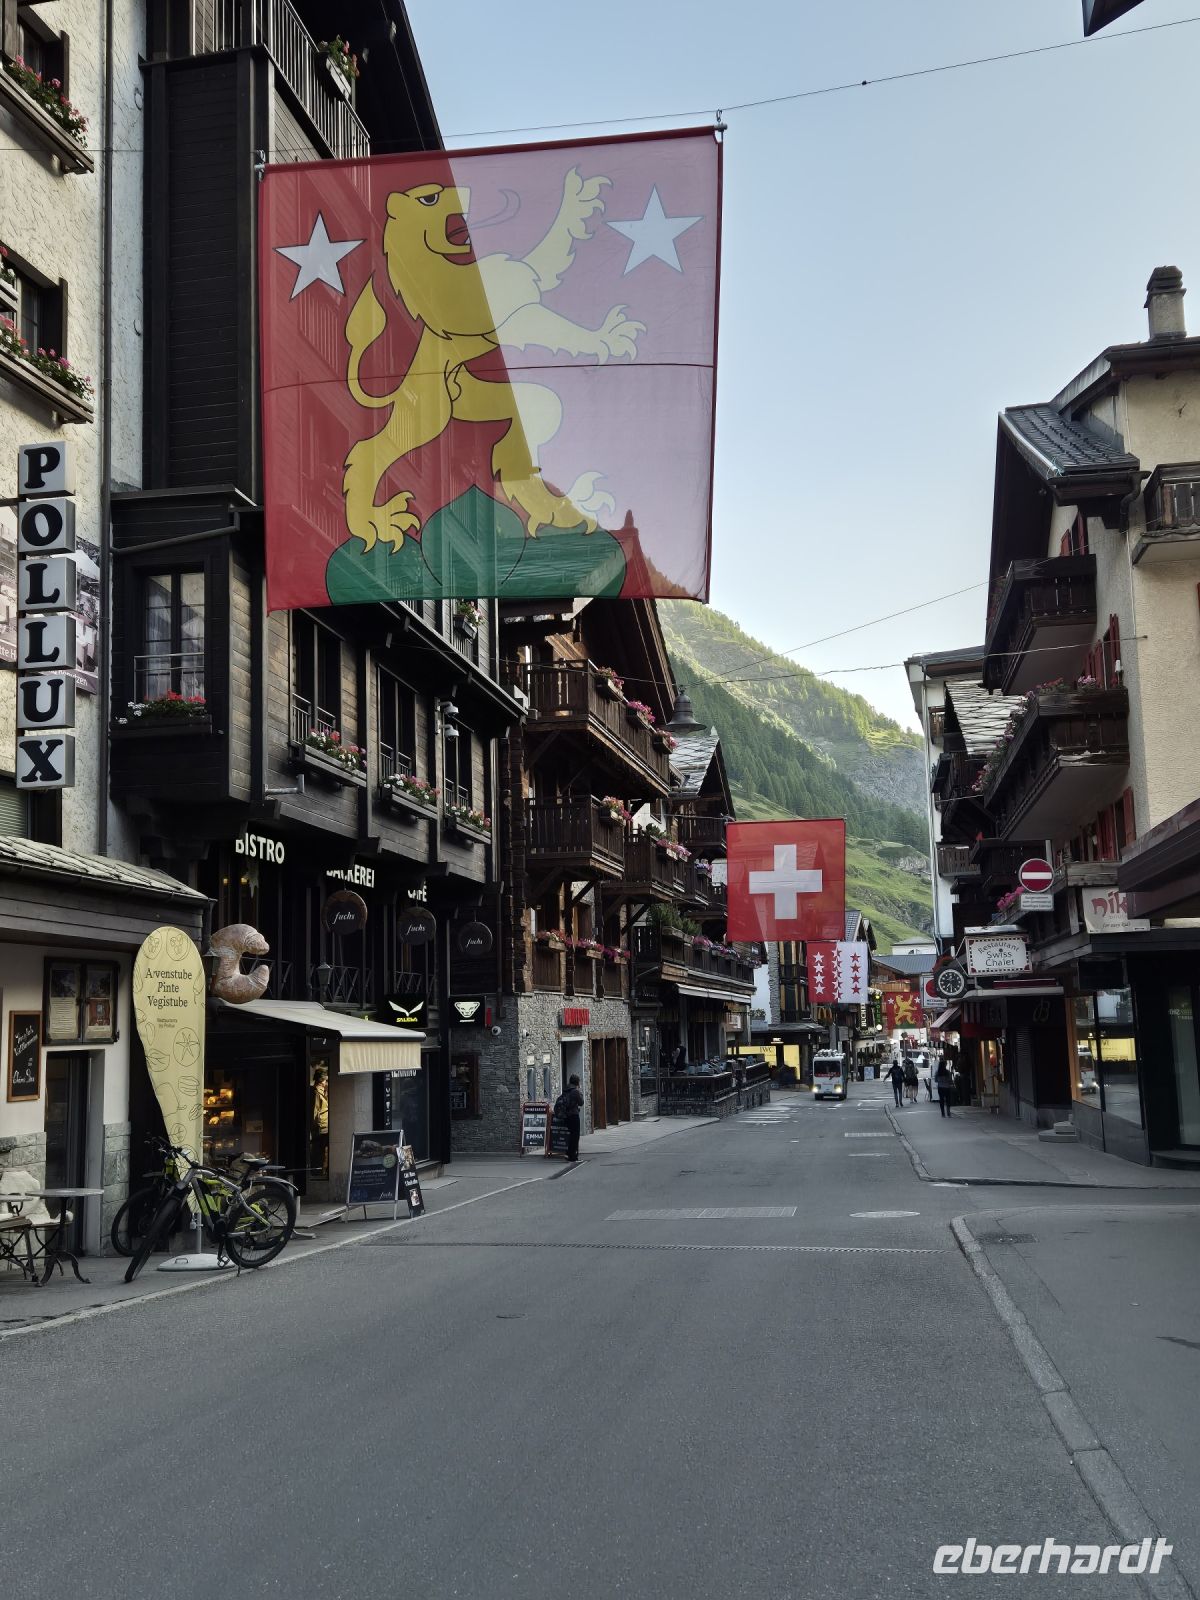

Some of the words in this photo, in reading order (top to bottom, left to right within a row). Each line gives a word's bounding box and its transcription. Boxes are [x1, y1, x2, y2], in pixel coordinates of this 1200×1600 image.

[19, 446, 63, 783] POLLUX
[235, 832, 285, 864] BISTRO
[332, 911, 356, 925] fuchs
[406, 923, 426, 936] fuchs
[466, 938, 483, 949] fuchs
[977, 941, 1020, 954] Restaurant
[986, 951, 1012, 959] Swiss
[985, 959, 1015, 967] Chalet
[145, 967, 192, 980] Arvenstube
[157, 981, 179, 993] Pinte
[147, 995, 188, 1010] Vegistube
